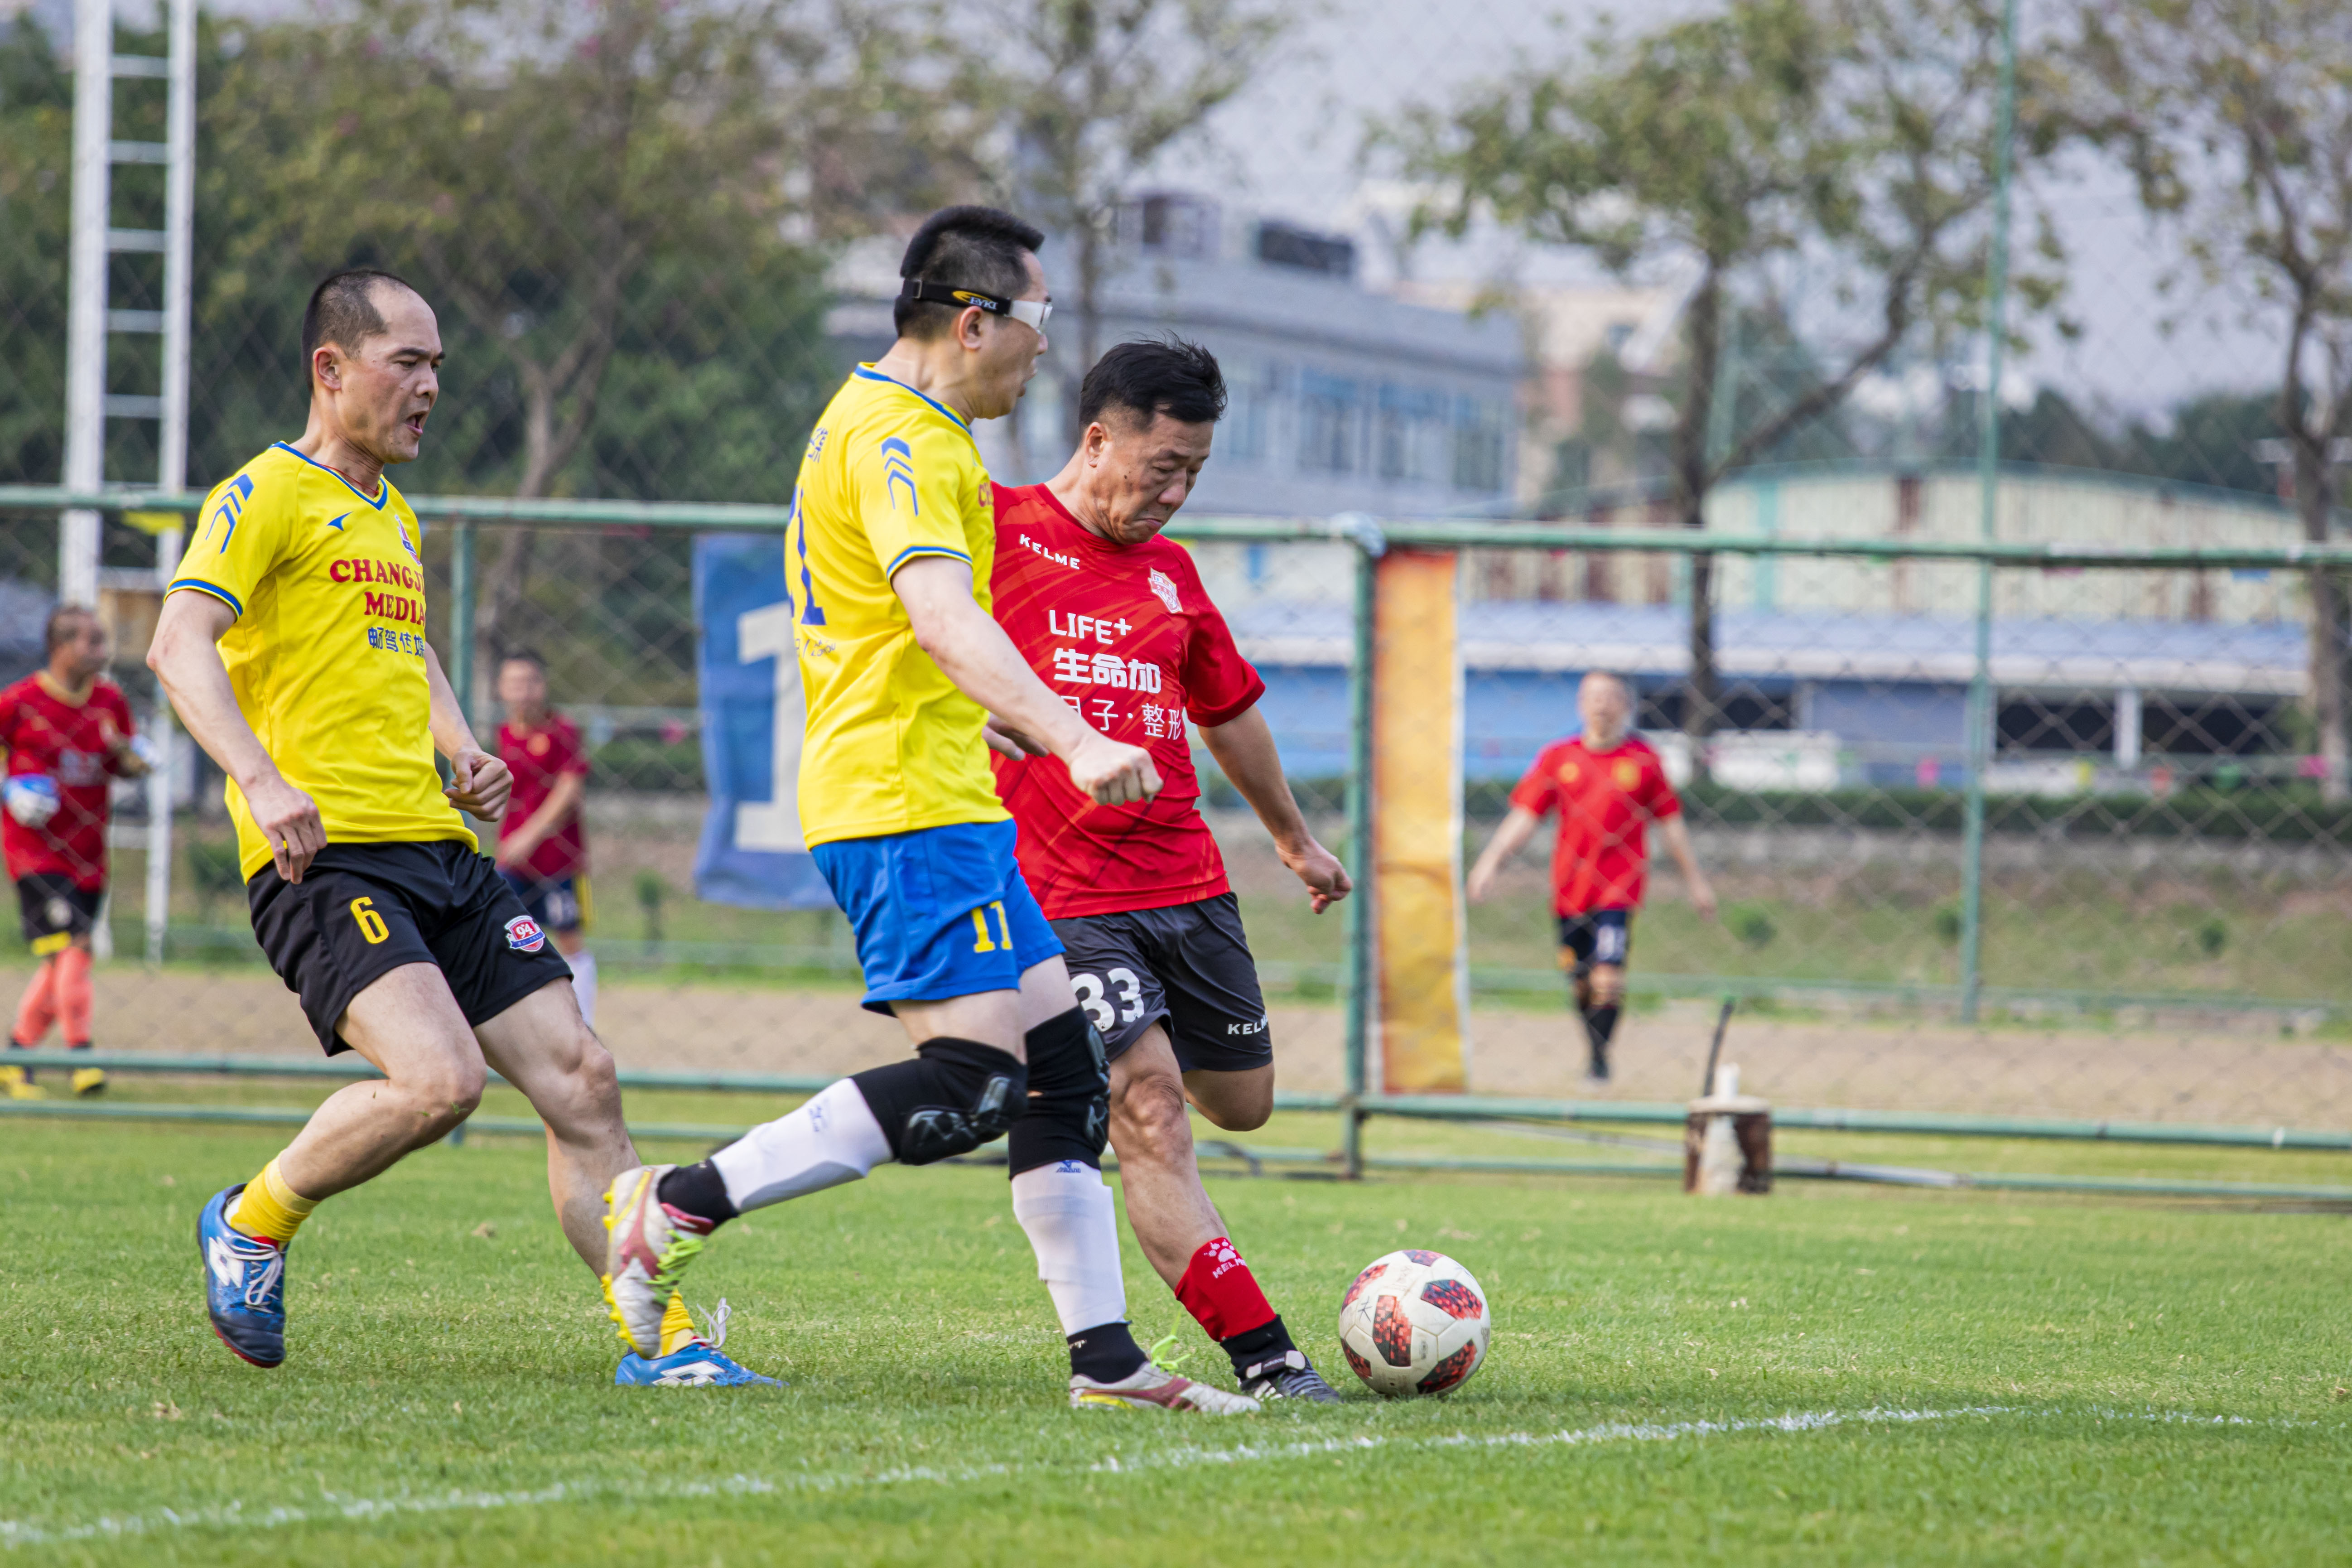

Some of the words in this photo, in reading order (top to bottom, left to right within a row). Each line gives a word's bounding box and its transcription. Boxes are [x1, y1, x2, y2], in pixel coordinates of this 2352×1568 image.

[1019, 534, 1080, 570] KELME
[364, 591, 425, 627] MEDIA
[1049, 609, 1133, 645] LIFE+
[1053, 647, 1162, 694] 生命加
[350, 896, 390, 945] 6
[516, 923, 535, 939] 94
[971, 900, 1013, 953] 11
[1070, 967, 1145, 1032] 33
